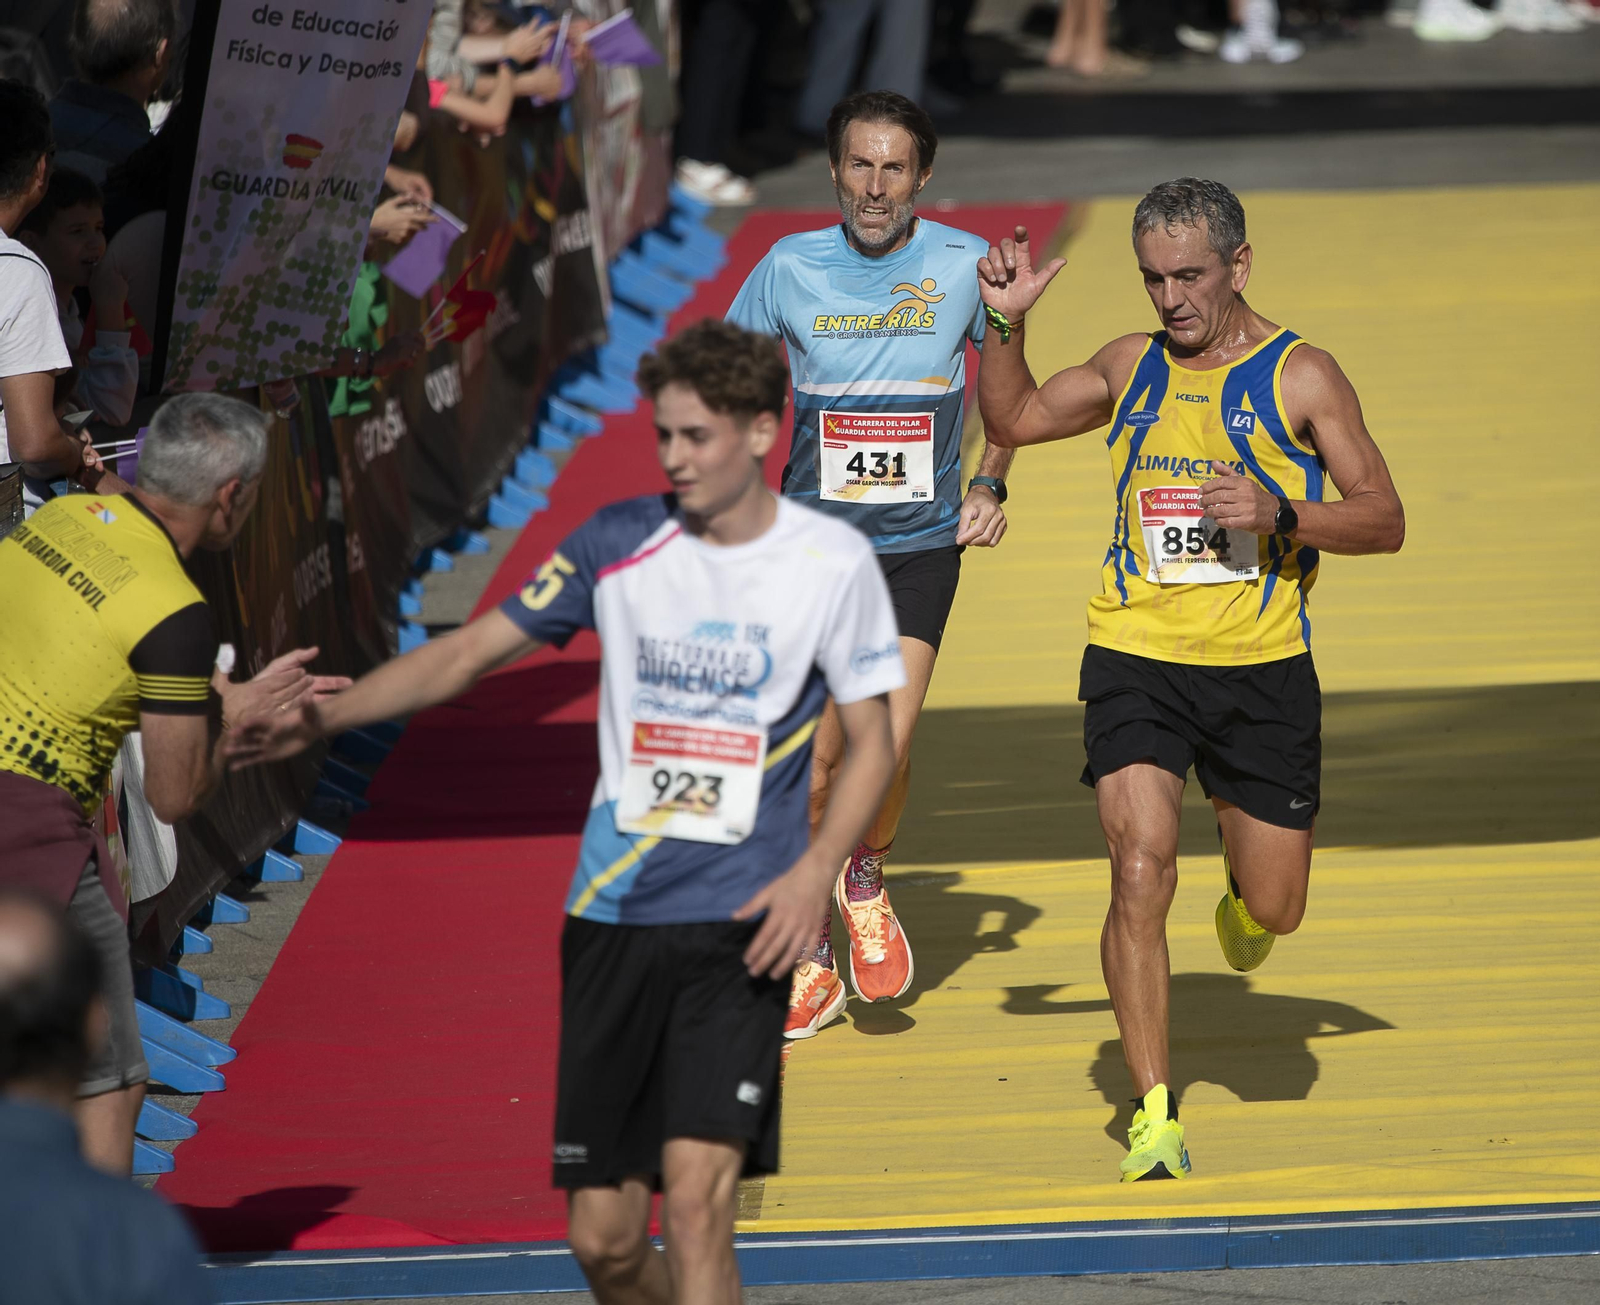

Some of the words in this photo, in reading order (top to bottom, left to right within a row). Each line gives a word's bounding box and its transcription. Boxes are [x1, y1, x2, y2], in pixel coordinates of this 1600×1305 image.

[252, 4, 284, 27] de
[226, 39, 293, 69] Física
[297, 53, 312, 75] y
[318, 53, 403, 81] Deportes
[211, 170, 310, 200] GUARDIA
[812, 315, 884, 331] ENTRE
[885, 307, 936, 330] RÍAS
[836, 331, 864, 340] GROVE
[866, 330, 872, 338] &
[874, 329, 919, 338] SANXENXO
[1175, 392, 1210, 403] KELTIA
[835, 427, 866, 436] GUARDIA
[896, 428, 928, 436] OURENSE
[853, 419, 885, 427] CARRERA
[1231, 414, 1251, 429] LA
[846, 451, 906, 478] 431
[1161, 526, 1231, 556] 854
[22, 535, 73, 578] GUARDIA
[66, 570, 107, 613] CIVIL
[636, 655, 750, 698] OURENSE
[652, 769, 724, 807] 923
